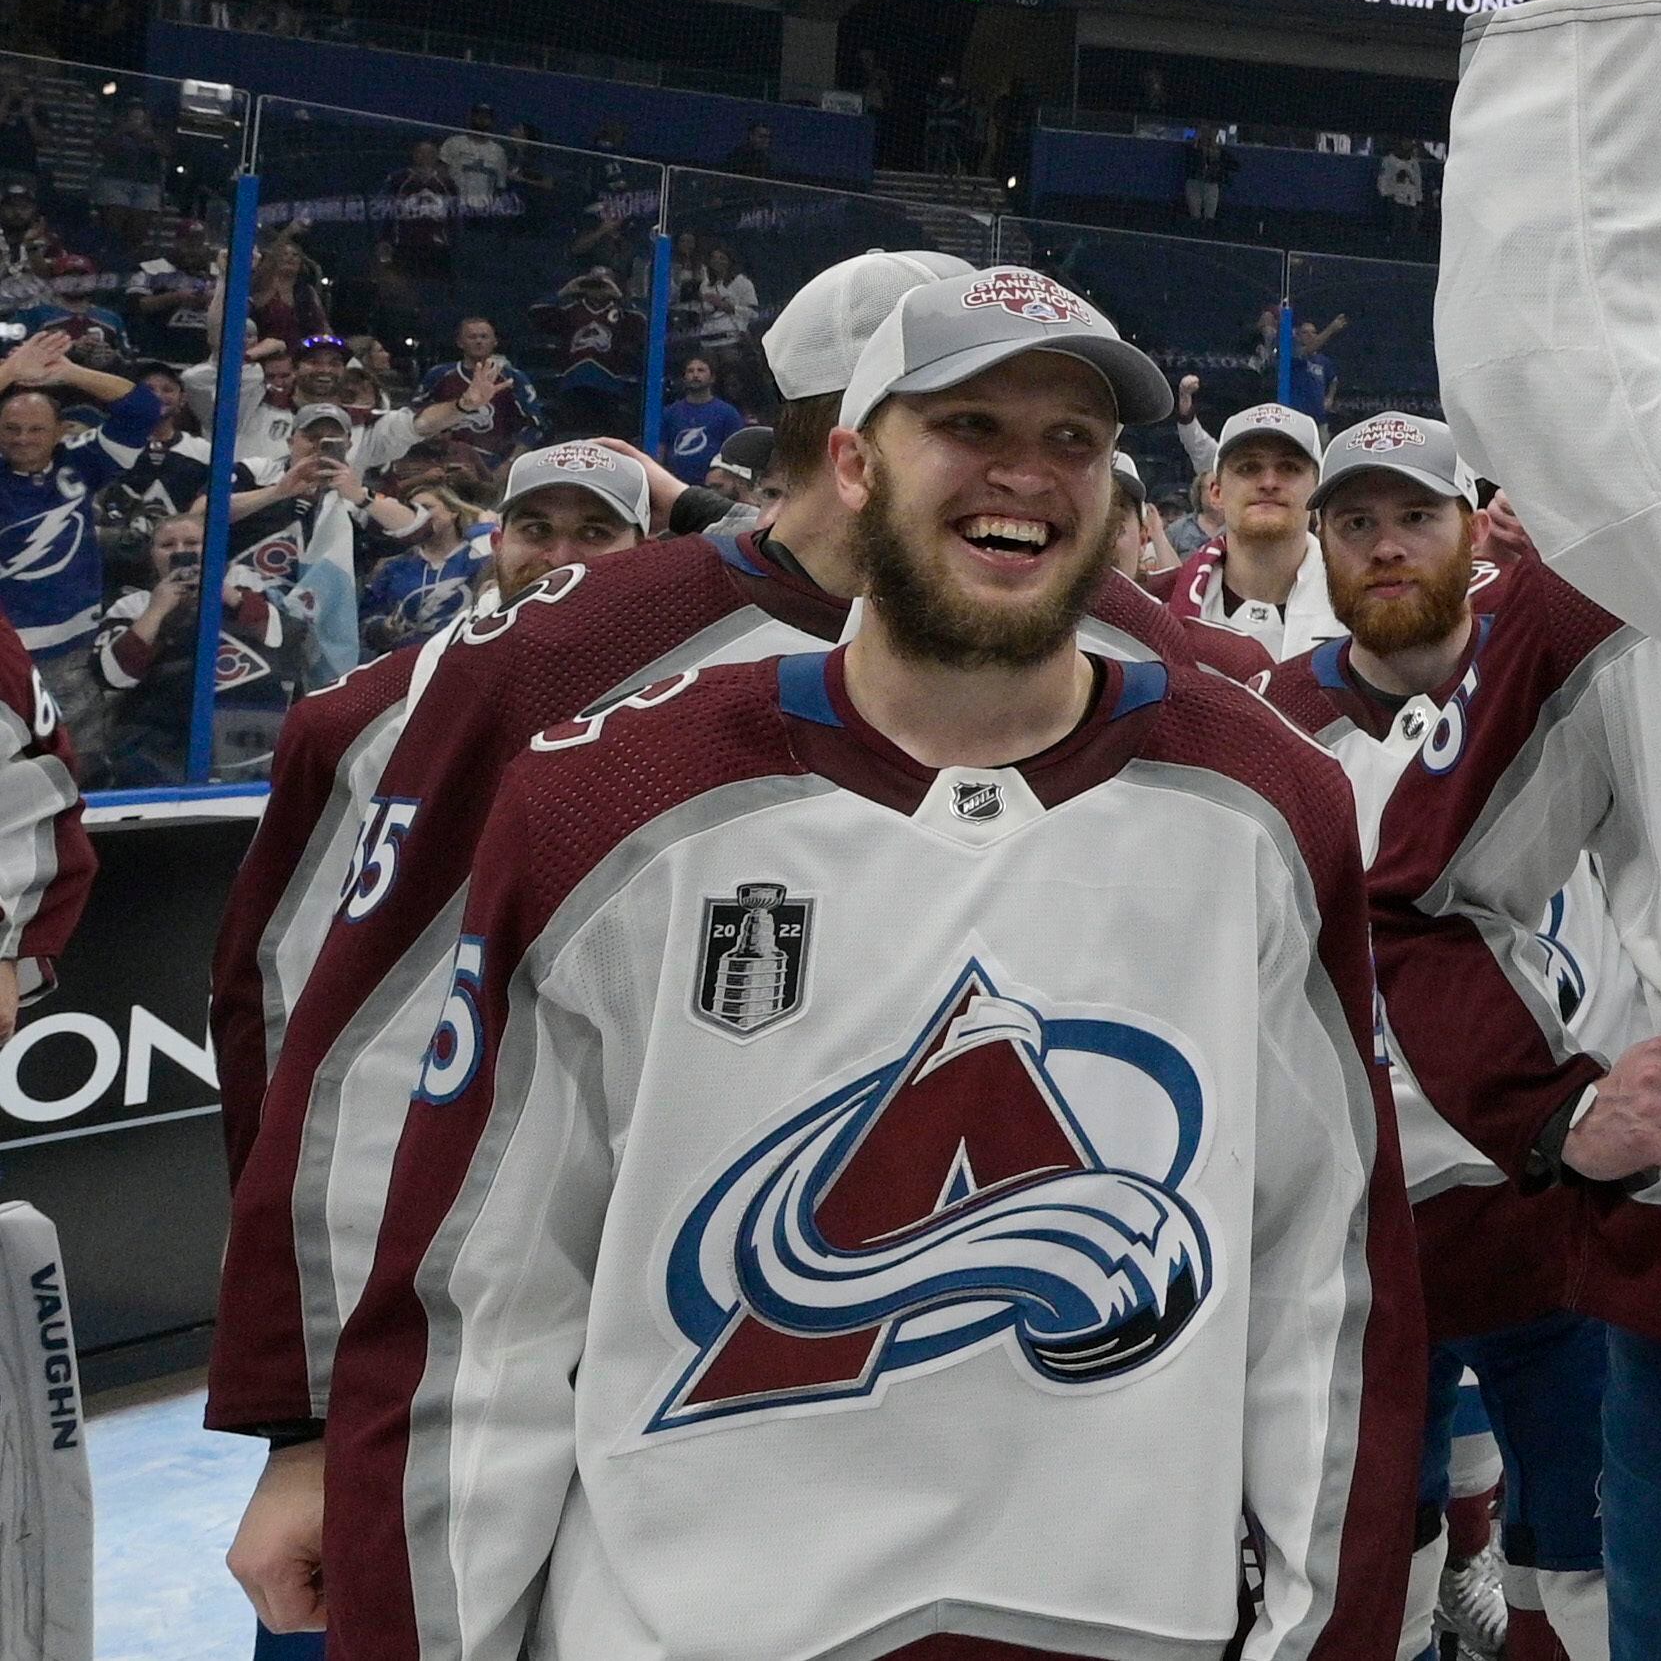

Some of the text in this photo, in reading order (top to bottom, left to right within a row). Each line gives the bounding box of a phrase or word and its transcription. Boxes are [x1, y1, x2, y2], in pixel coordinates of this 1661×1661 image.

[976, 278, 1078, 303] STANLEY CUP
[965, 288, 1091, 325] CHAMPIONS
[963, 790, 996, 815] NHL
[713, 923, 736, 939] 20
[779, 923, 801, 939] 22
[30, 1262, 78, 1451] VAUGHN
